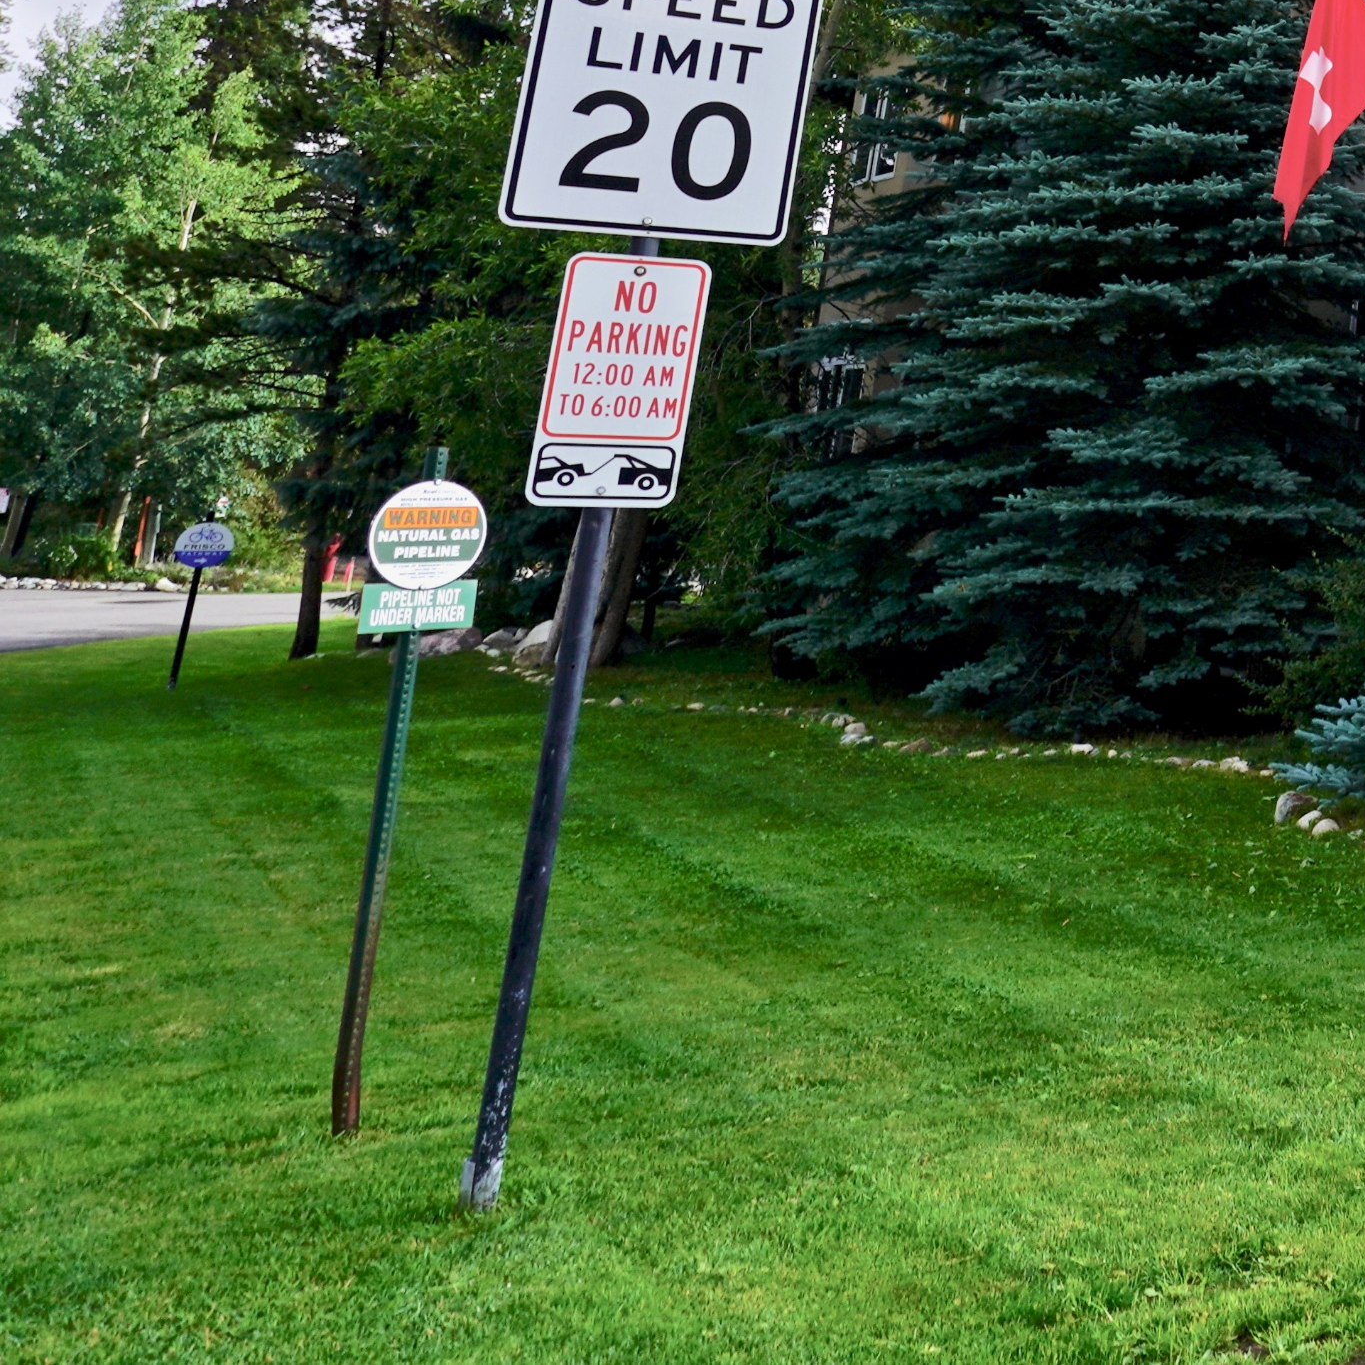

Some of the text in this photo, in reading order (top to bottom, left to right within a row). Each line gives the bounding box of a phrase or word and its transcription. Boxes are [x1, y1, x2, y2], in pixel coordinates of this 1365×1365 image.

[586, 26, 763, 84] LIMIT
[558, 90, 752, 201] 20
[613, 280, 657, 315] NO
[567, 321, 689, 359] PARKING
[572, 363, 674, 388] 12:00 AM
[560, 393, 678, 420] TO 6:00 AM
[390, 510, 472, 525] WARNING
[378, 528, 480, 542] NATURAL GAS
[394, 546, 461, 559] PIPELINE
[380, 588, 461, 608] PIPELINE NOT
[369, 605, 466, 626] UNDER MARKER
